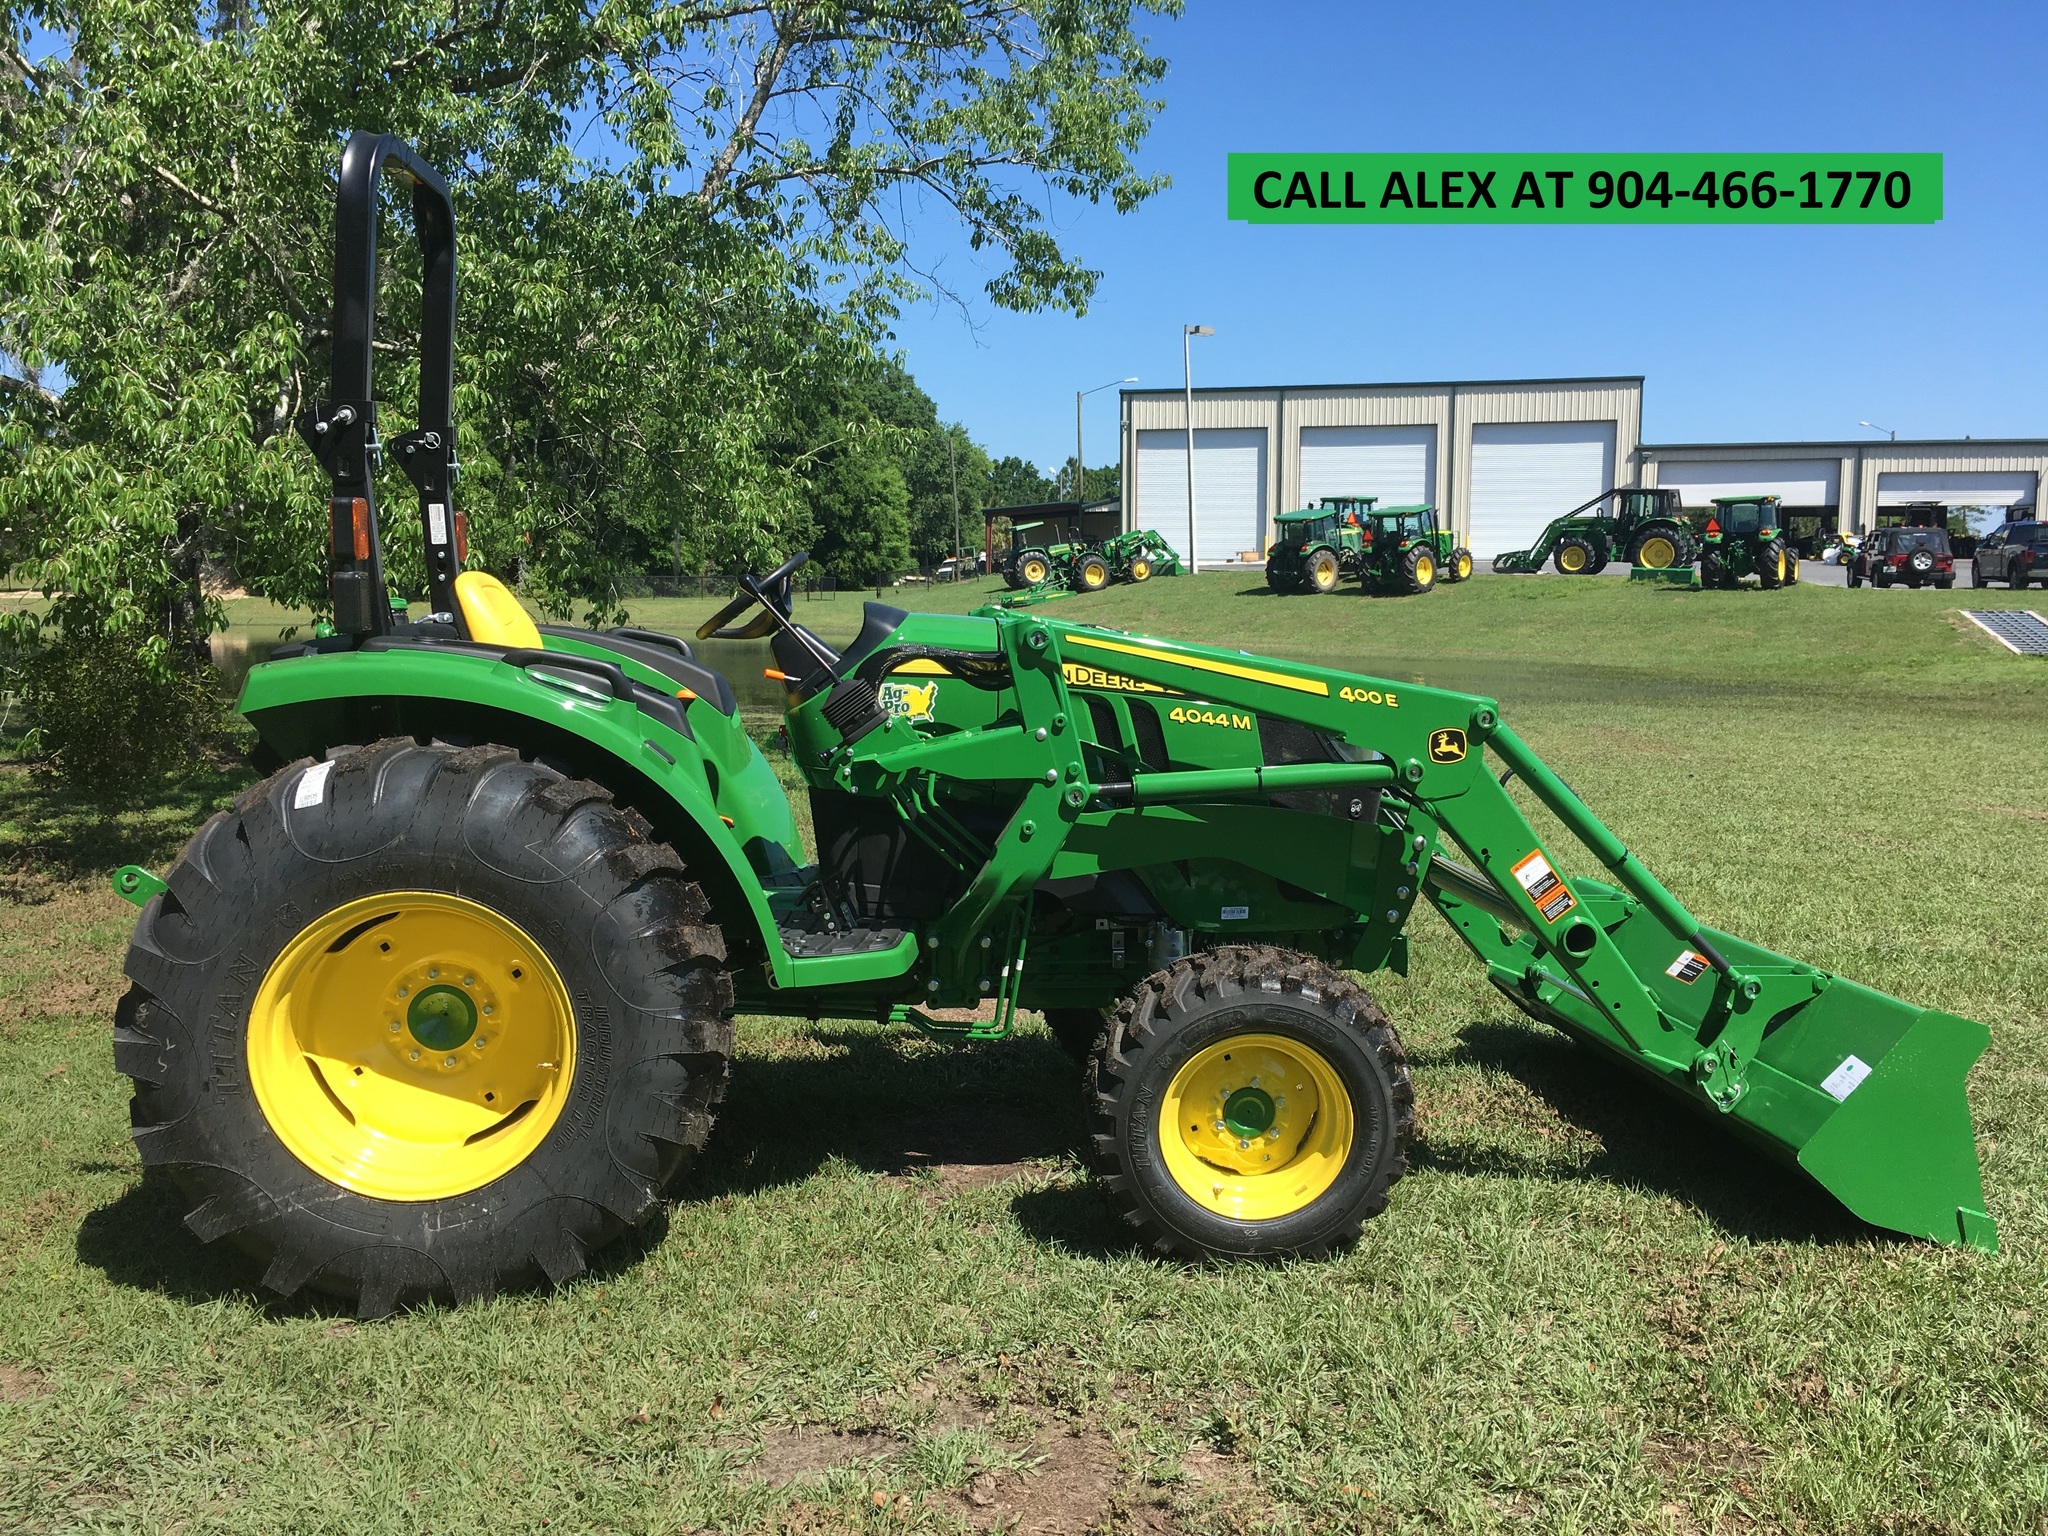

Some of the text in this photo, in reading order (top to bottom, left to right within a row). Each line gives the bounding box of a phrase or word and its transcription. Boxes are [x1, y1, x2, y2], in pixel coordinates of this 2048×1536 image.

[882, 686, 909, 701] Ag-
[883, 701, 910, 714] Pro
[1169, 706, 1252, 731] 4044 M
[1338, 686, 1399, 708] 400 E
[206, 951, 258, 1106] TITAN
[552, 989, 598, 1153] TRACTOR LUG
[580, 1005, 612, 1140] INDUSTRIAL
[1130, 1083, 1154, 1171] TITAN
